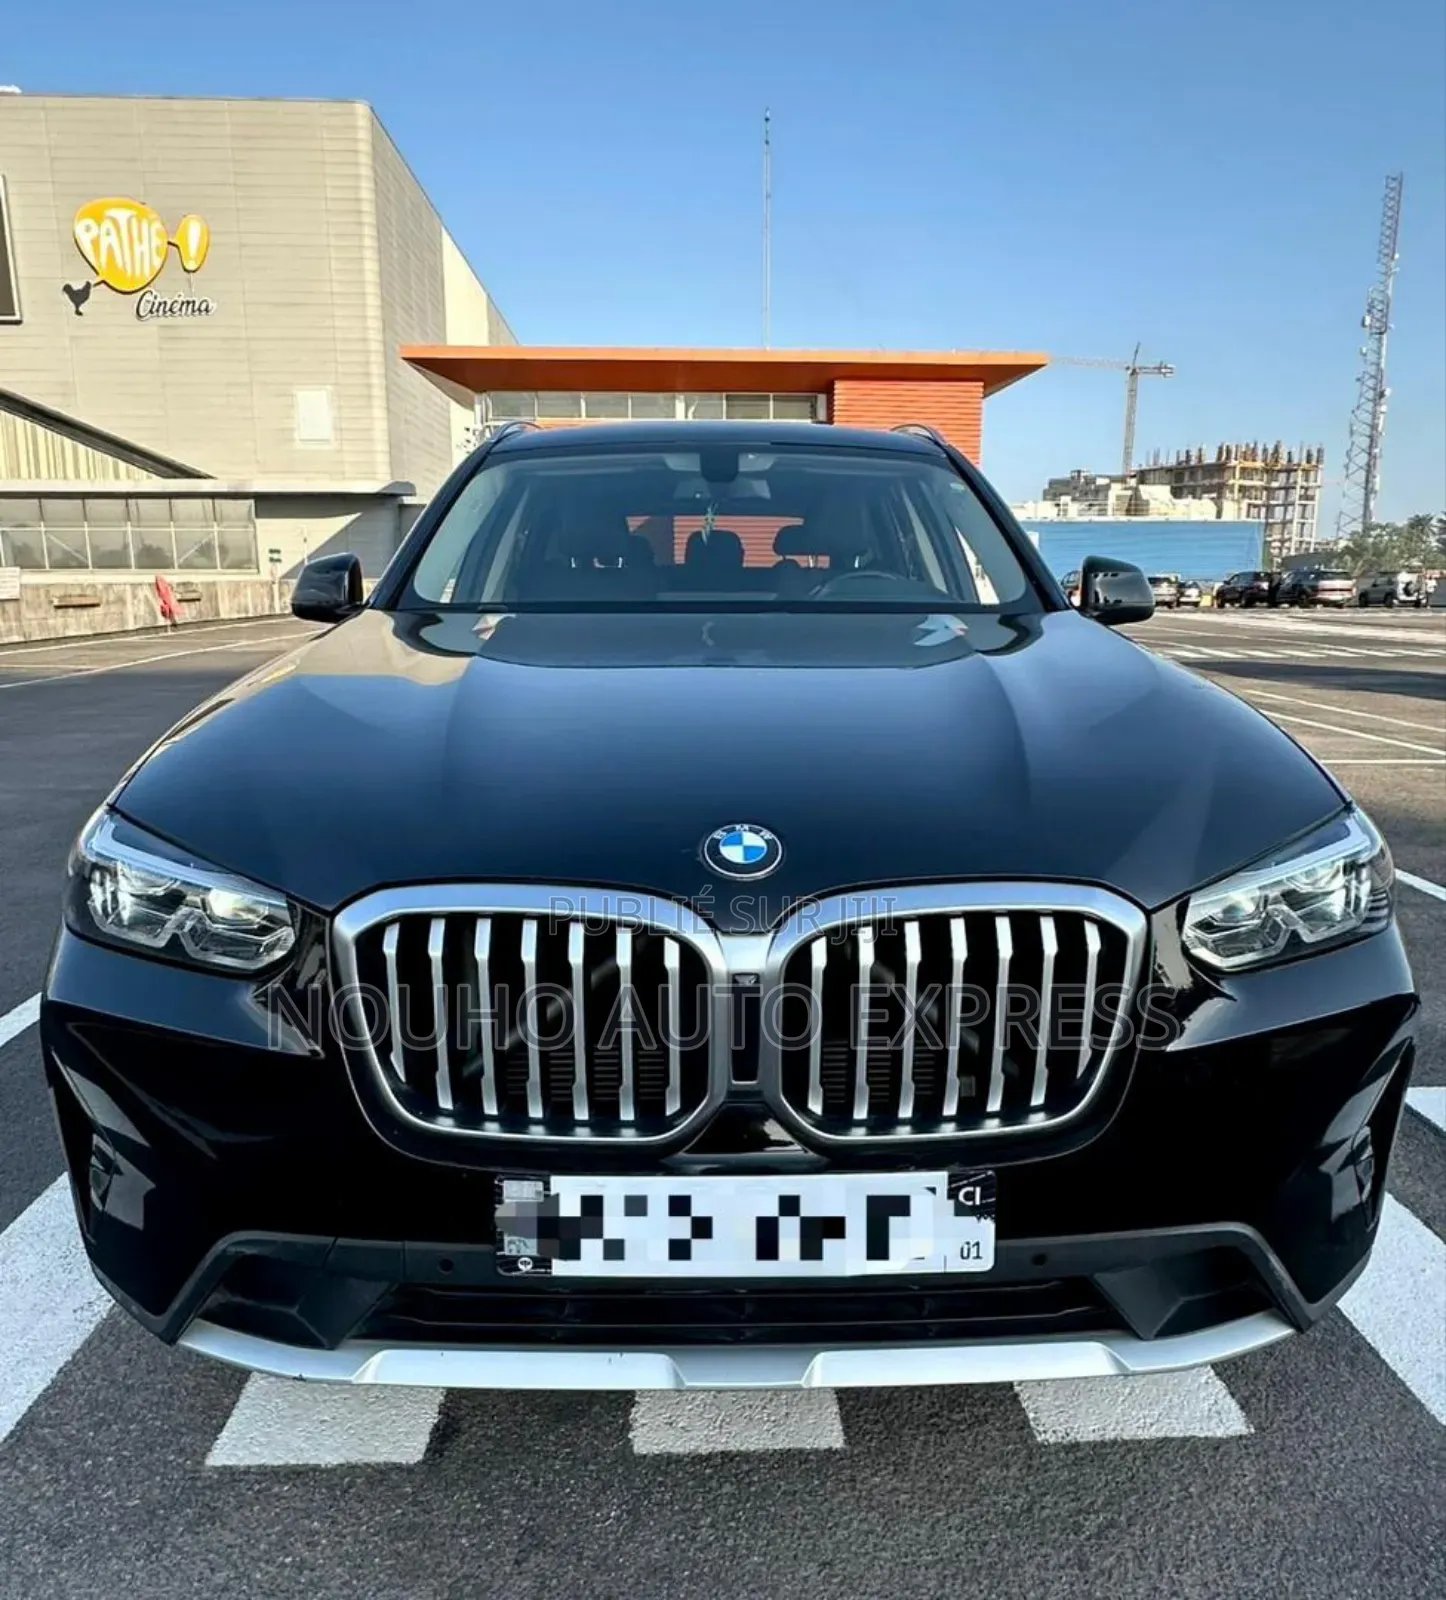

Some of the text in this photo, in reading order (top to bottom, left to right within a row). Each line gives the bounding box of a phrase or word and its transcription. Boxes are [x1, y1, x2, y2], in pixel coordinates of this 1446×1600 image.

[136, 289, 213, 320] Cinéma
[958, 1186, 981, 1206] CI
[960, 1240, 983, 1260] 01
